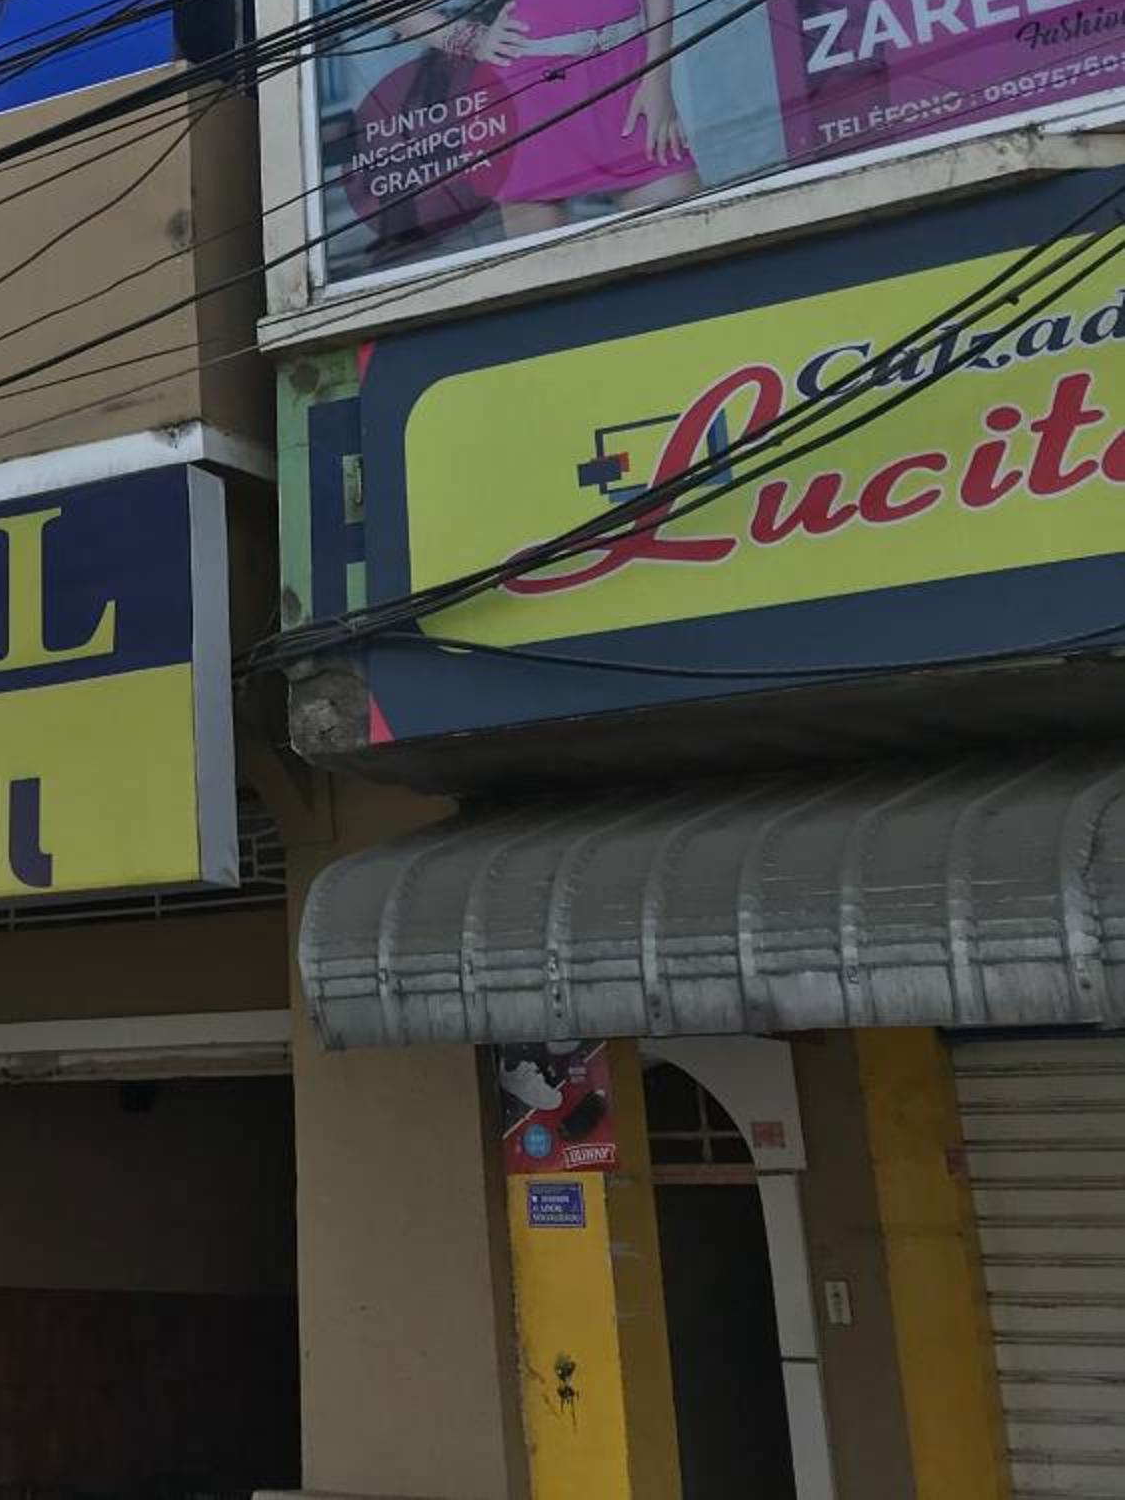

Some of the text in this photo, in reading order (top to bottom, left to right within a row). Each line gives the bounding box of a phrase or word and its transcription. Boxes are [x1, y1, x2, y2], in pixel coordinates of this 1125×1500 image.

[352, 114, 507, 172] INSCRIPCIÓN
[365, 91, 489, 142] PUNTO DE
